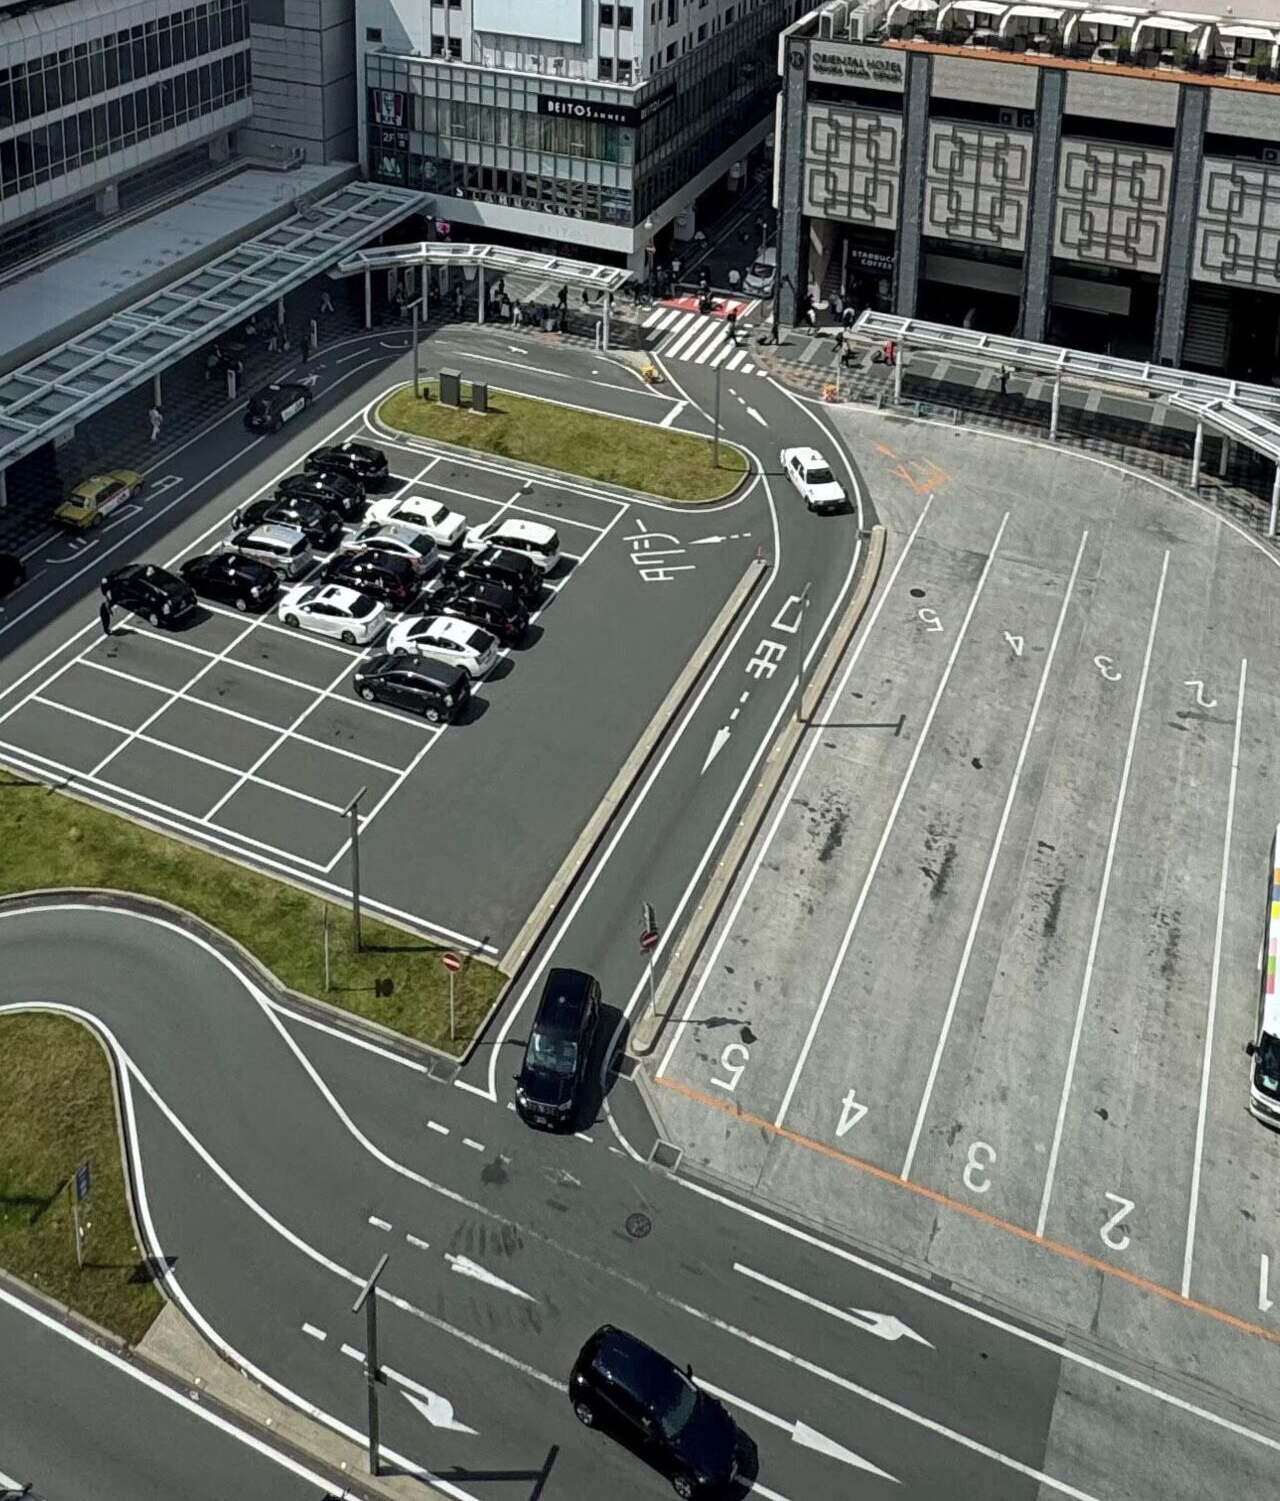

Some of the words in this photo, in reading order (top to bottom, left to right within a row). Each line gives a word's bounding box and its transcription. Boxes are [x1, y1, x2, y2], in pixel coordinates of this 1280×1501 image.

[813, 53, 865, 69] ORIENTAL
[867, 59, 902, 73] HOTEL
[548, 101, 592, 117] BEITOS
[623, 519, 696, 582] タクシー
[745, 595, 810, 679] 出口
[918, 608, 945, 633] 5
[1003, 630, 1024, 657] 4
[1093, 654, 1122, 681] 3
[1184, 680, 1218, 708] 2
[710, 1043, 751, 1093] 5
[835, 1089, 869, 1137] 4
[961, 1141, 998, 1194] 3
[1100, 1192, 1136, 1253] 2
